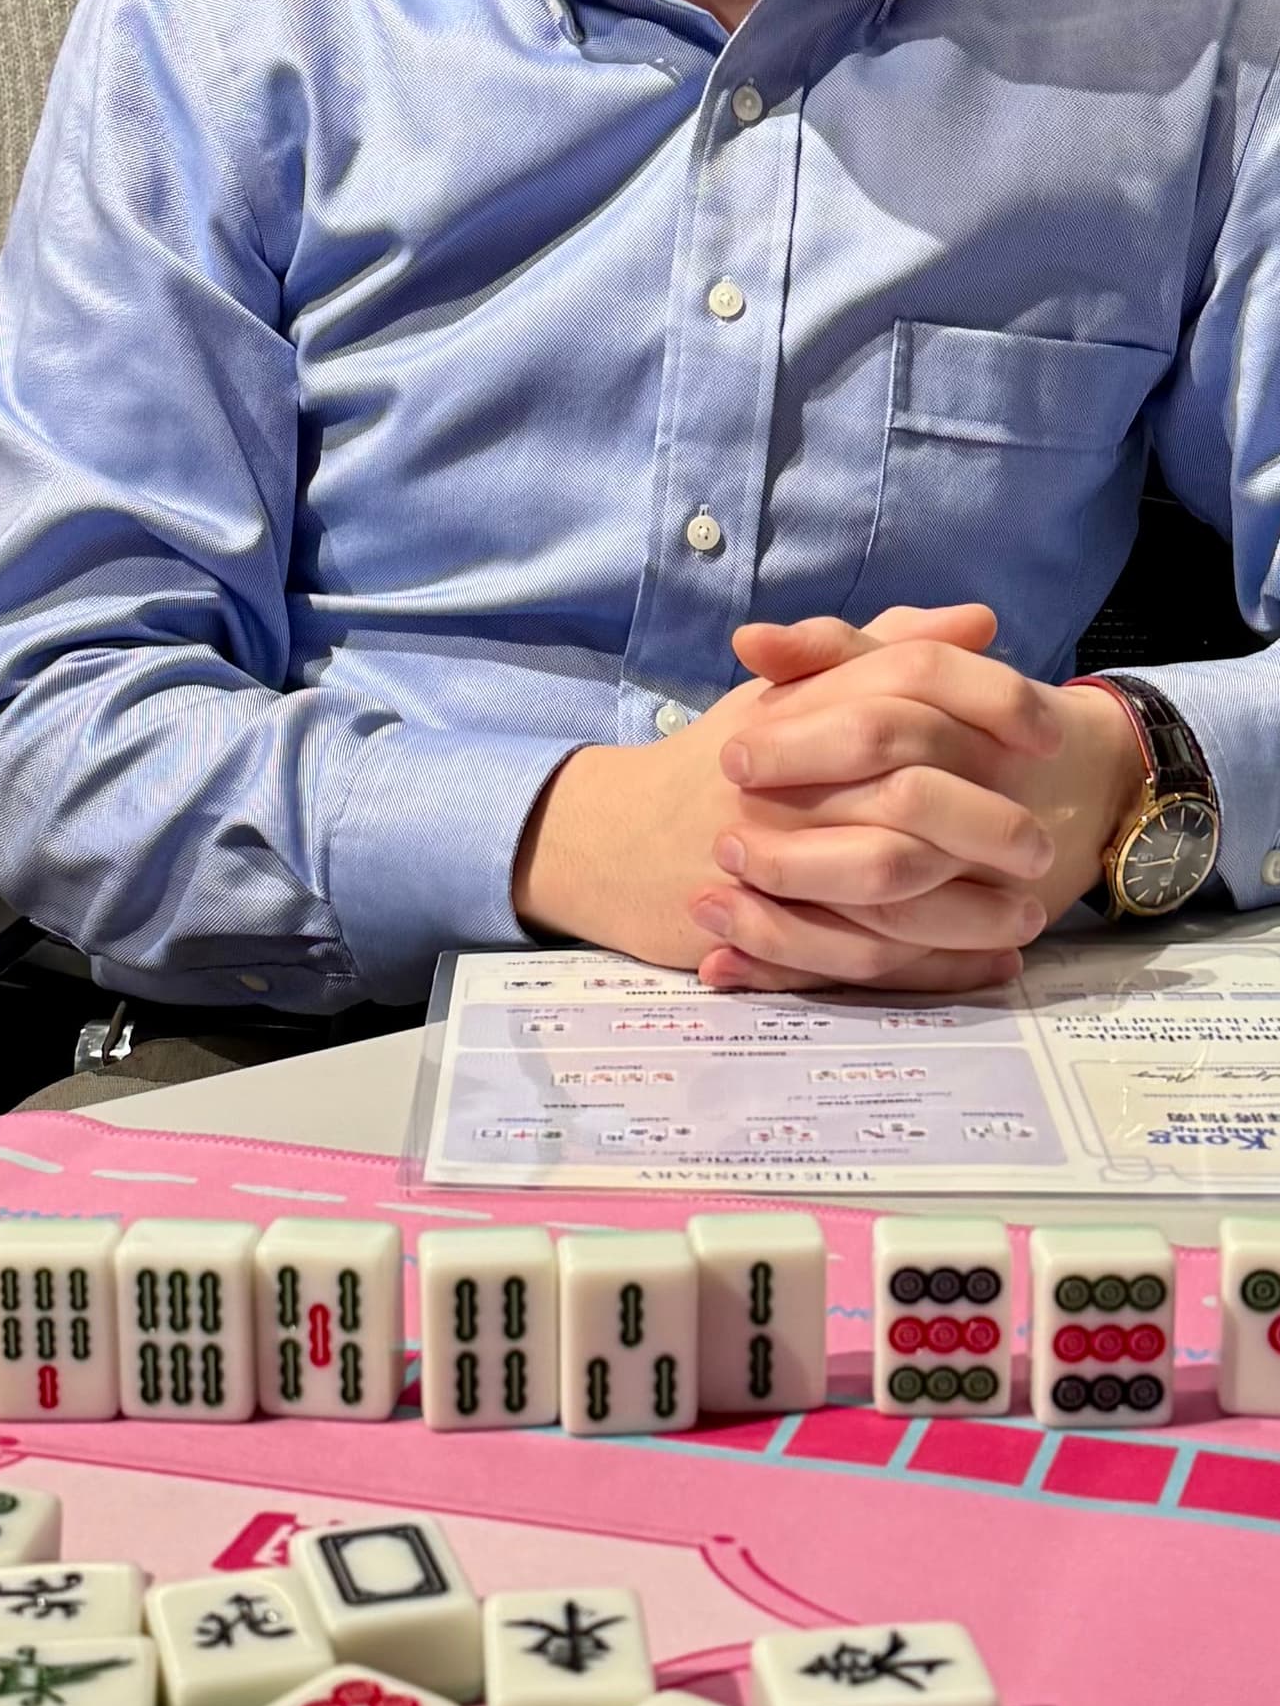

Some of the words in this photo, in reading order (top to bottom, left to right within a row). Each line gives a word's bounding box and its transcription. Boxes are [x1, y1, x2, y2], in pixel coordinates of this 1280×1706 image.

[1069, 1033, 1191, 1043] objective
[1146, 1131, 1272, 1150] Kong
[635, 1171, 795, 1180] GLOSSARY
[803, 1172, 874, 1181] TILE
[198, 1595, 292, 1647] 北
[512, 1602, 618, 1674] 東
[802, 1633, 947, 1689] 東
